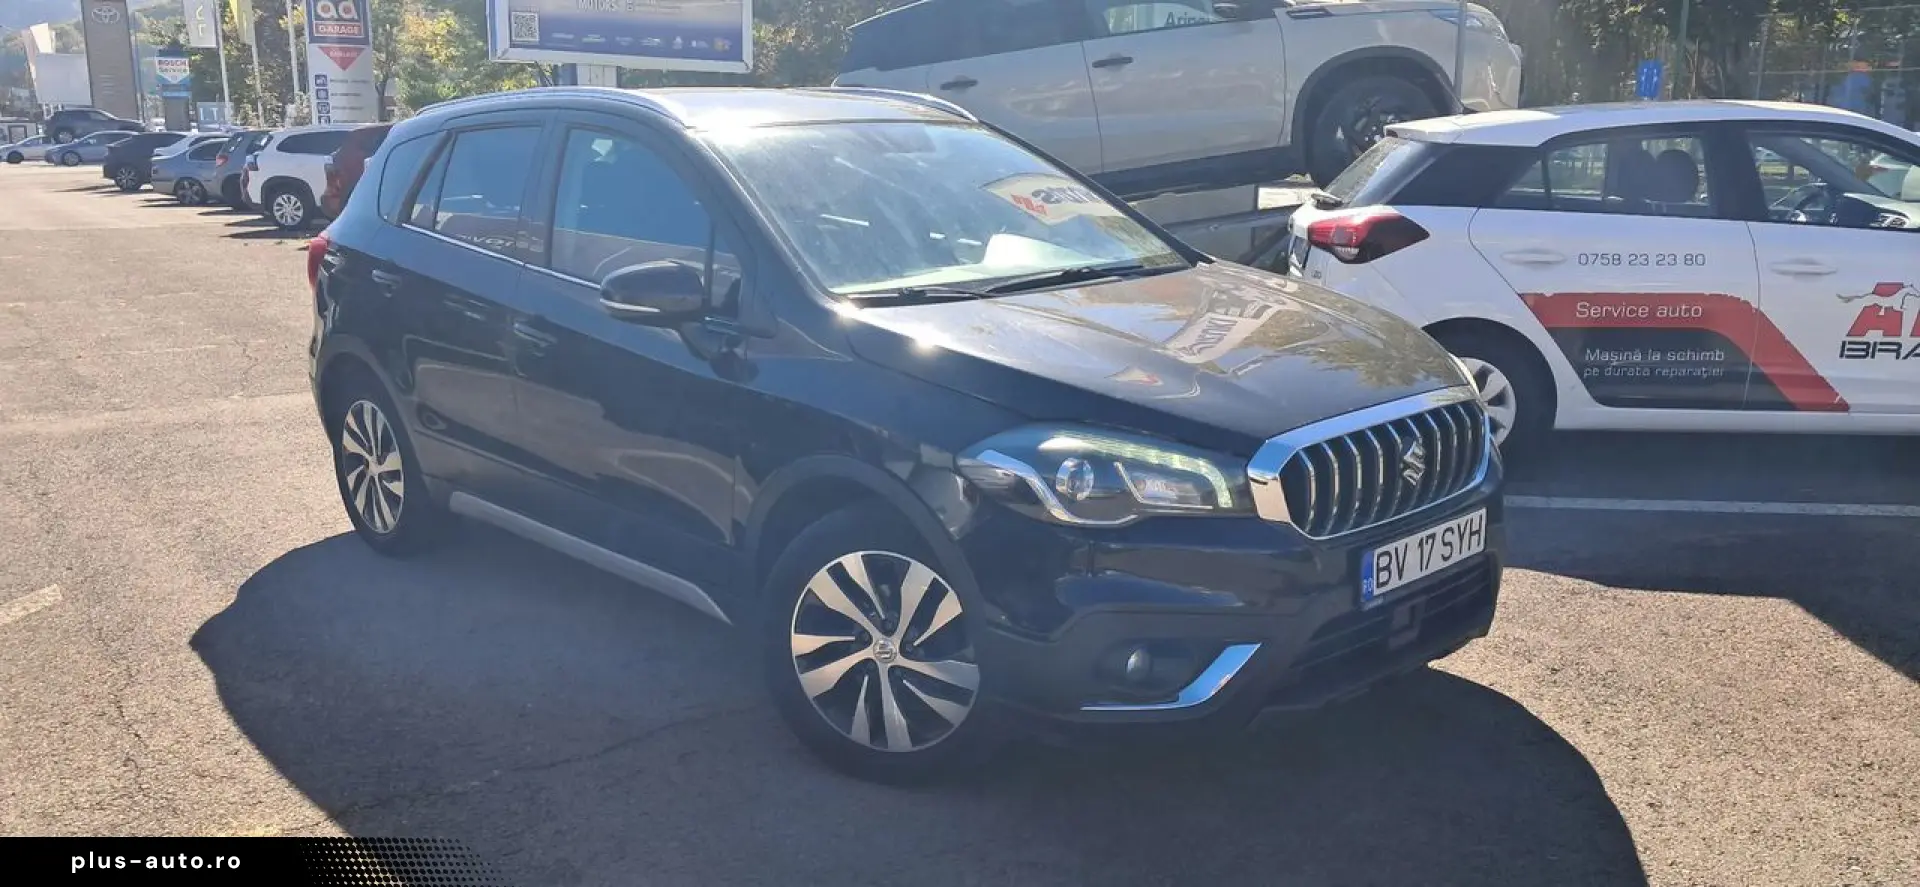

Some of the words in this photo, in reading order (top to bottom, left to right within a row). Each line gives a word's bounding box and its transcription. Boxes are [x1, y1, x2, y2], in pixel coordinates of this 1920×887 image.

[1578, 253, 1622, 266] 0758
[1628, 253, 1649, 266] 23
[1655, 253, 1678, 266] 23
[1684, 253, 1706, 266] 80
[1576, 301, 1649, 318] Service
[1657, 303, 1702, 318] auto
[1846, 282, 1920, 337] A
[1648, 349, 1661, 361] la
[1667, 348, 1725, 361] schimb
[1584, 367, 1600, 378] pe
[1604, 366, 1650, 376] durata
[1376, 543, 1408, 589] BV
[1418, 532, 1436, 573] 17
[1441, 514, 1483, 562] SYH
